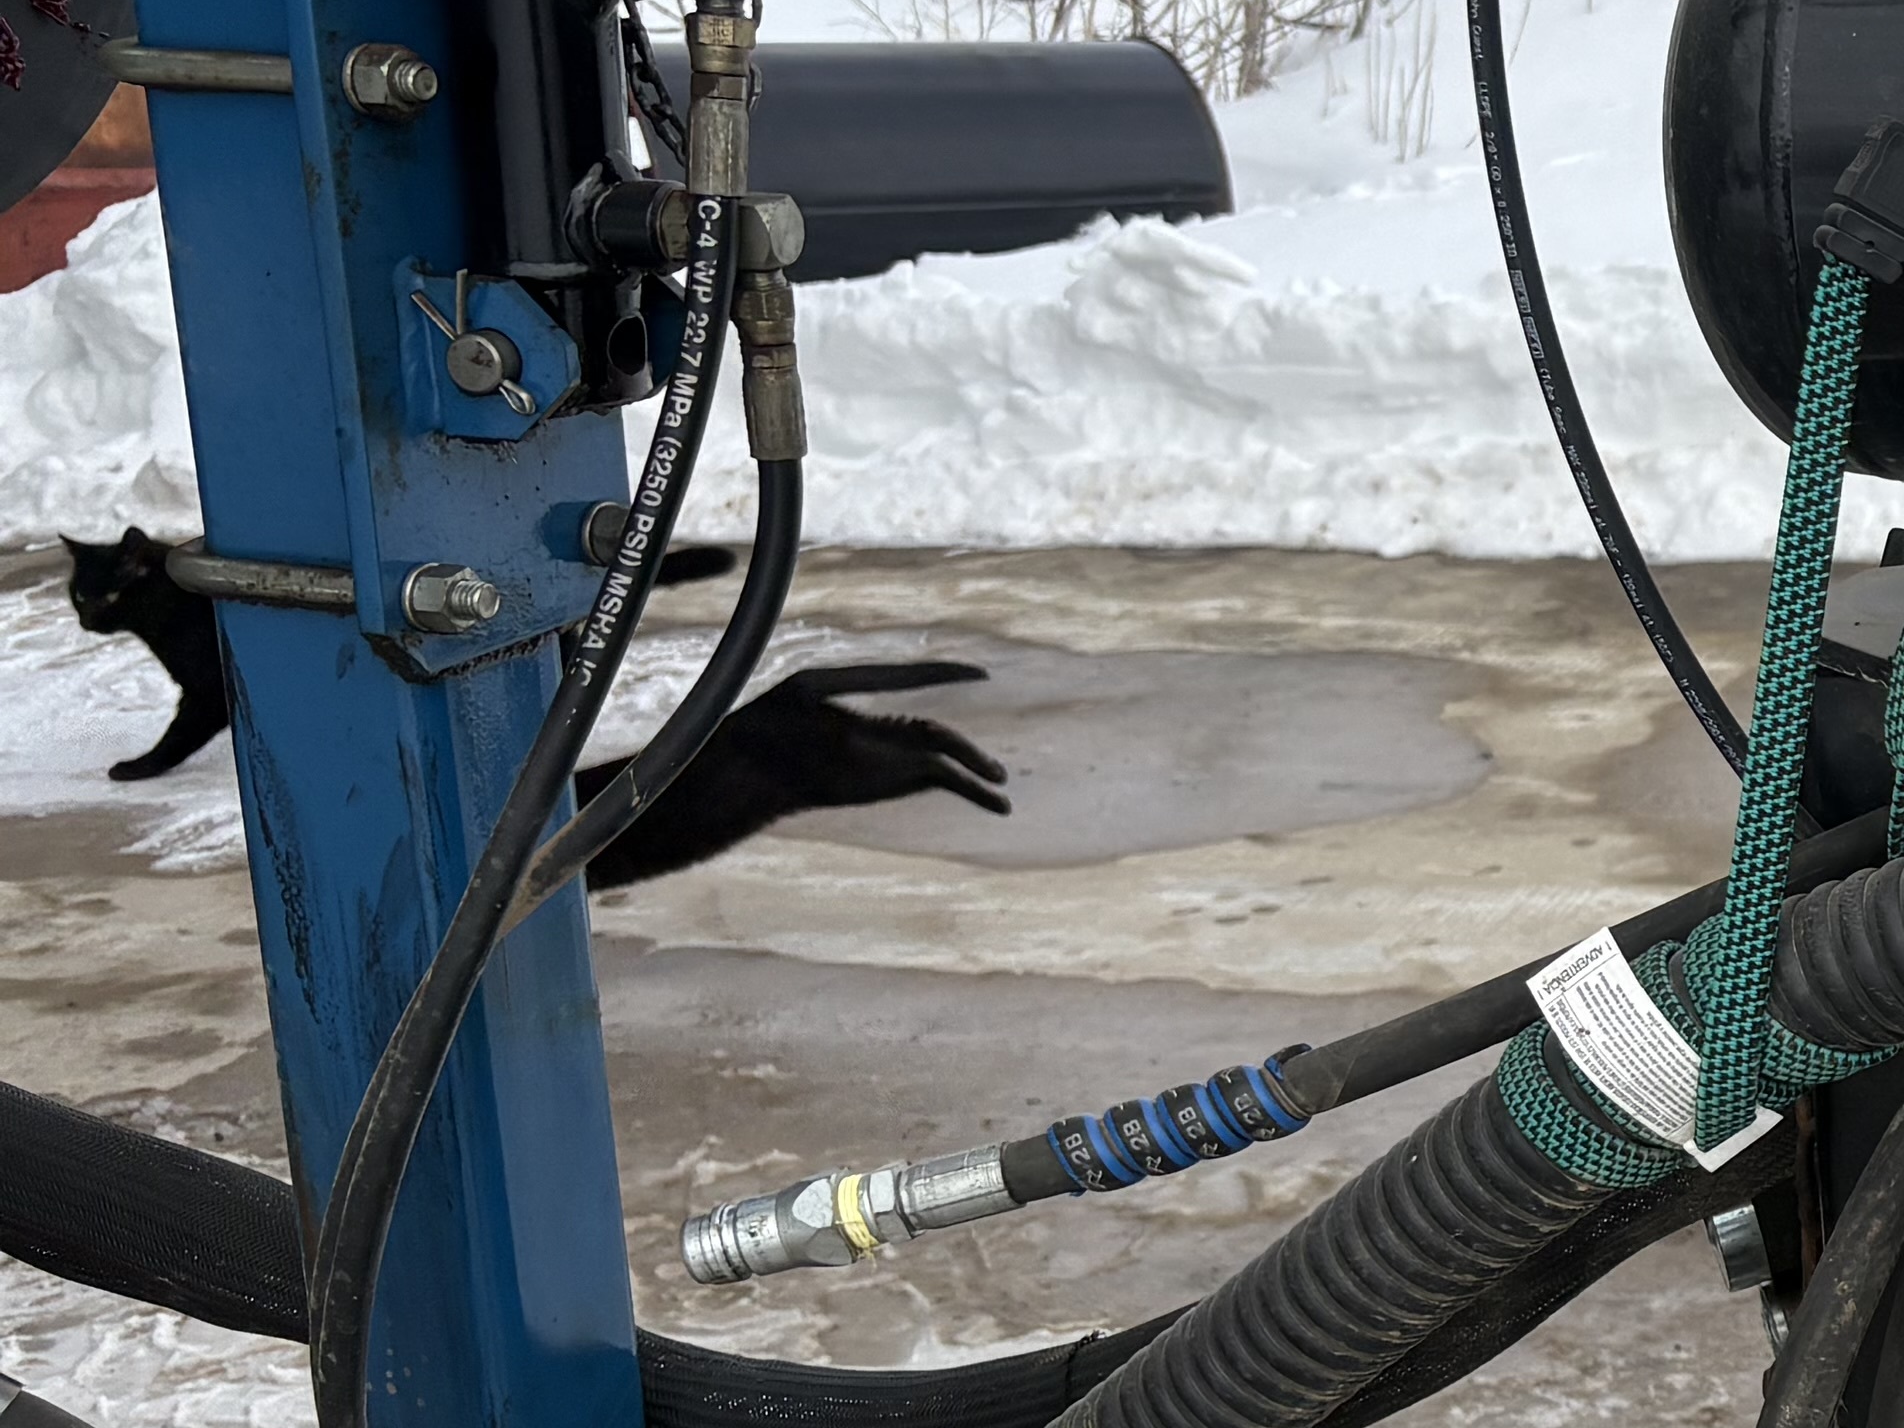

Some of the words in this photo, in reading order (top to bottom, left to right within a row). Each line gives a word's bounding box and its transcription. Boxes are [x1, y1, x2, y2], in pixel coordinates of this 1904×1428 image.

[663, 371, 699, 429] MPa
[639, 435, 684, 510] (3250
[616, 509, 660, 569] PSI)
[581, 571, 634, 650] MSHA
